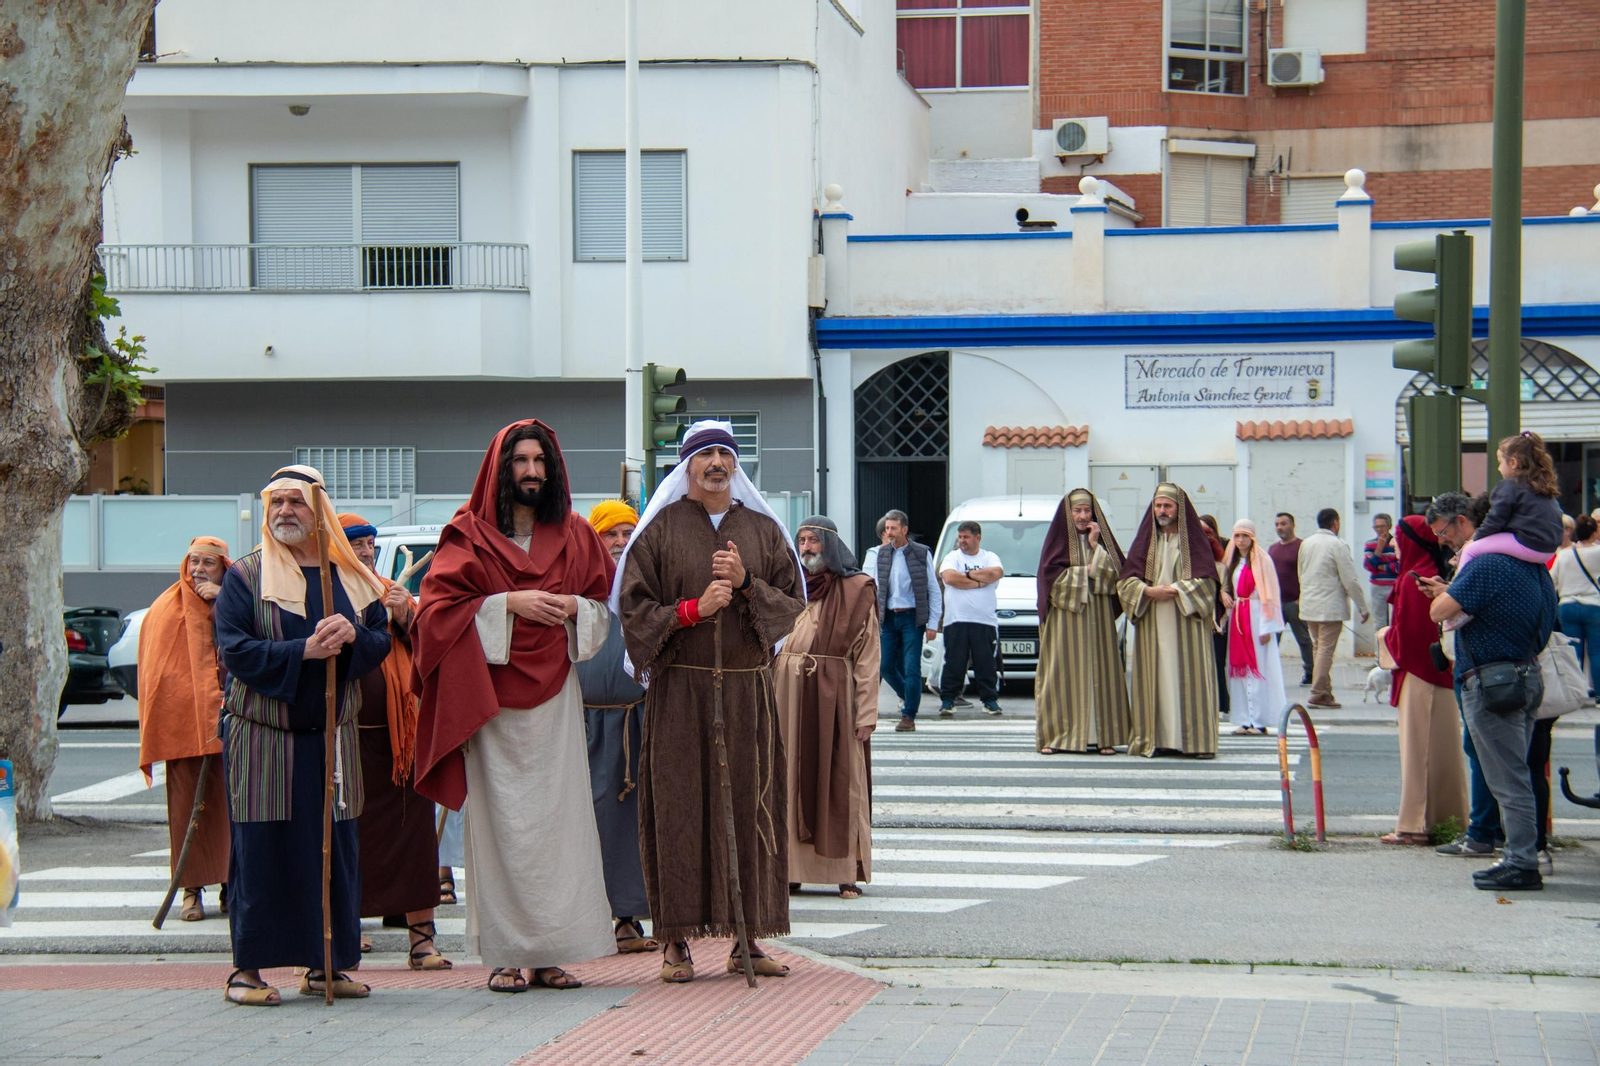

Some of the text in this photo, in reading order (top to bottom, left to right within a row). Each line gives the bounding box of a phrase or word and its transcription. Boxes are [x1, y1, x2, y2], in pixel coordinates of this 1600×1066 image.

[1134, 357, 1325, 379] Mercado de Torrenueva
[1136, 386, 1293, 403] Antonia Sánchez Genot
[1012, 643, 1032, 653] KDR
